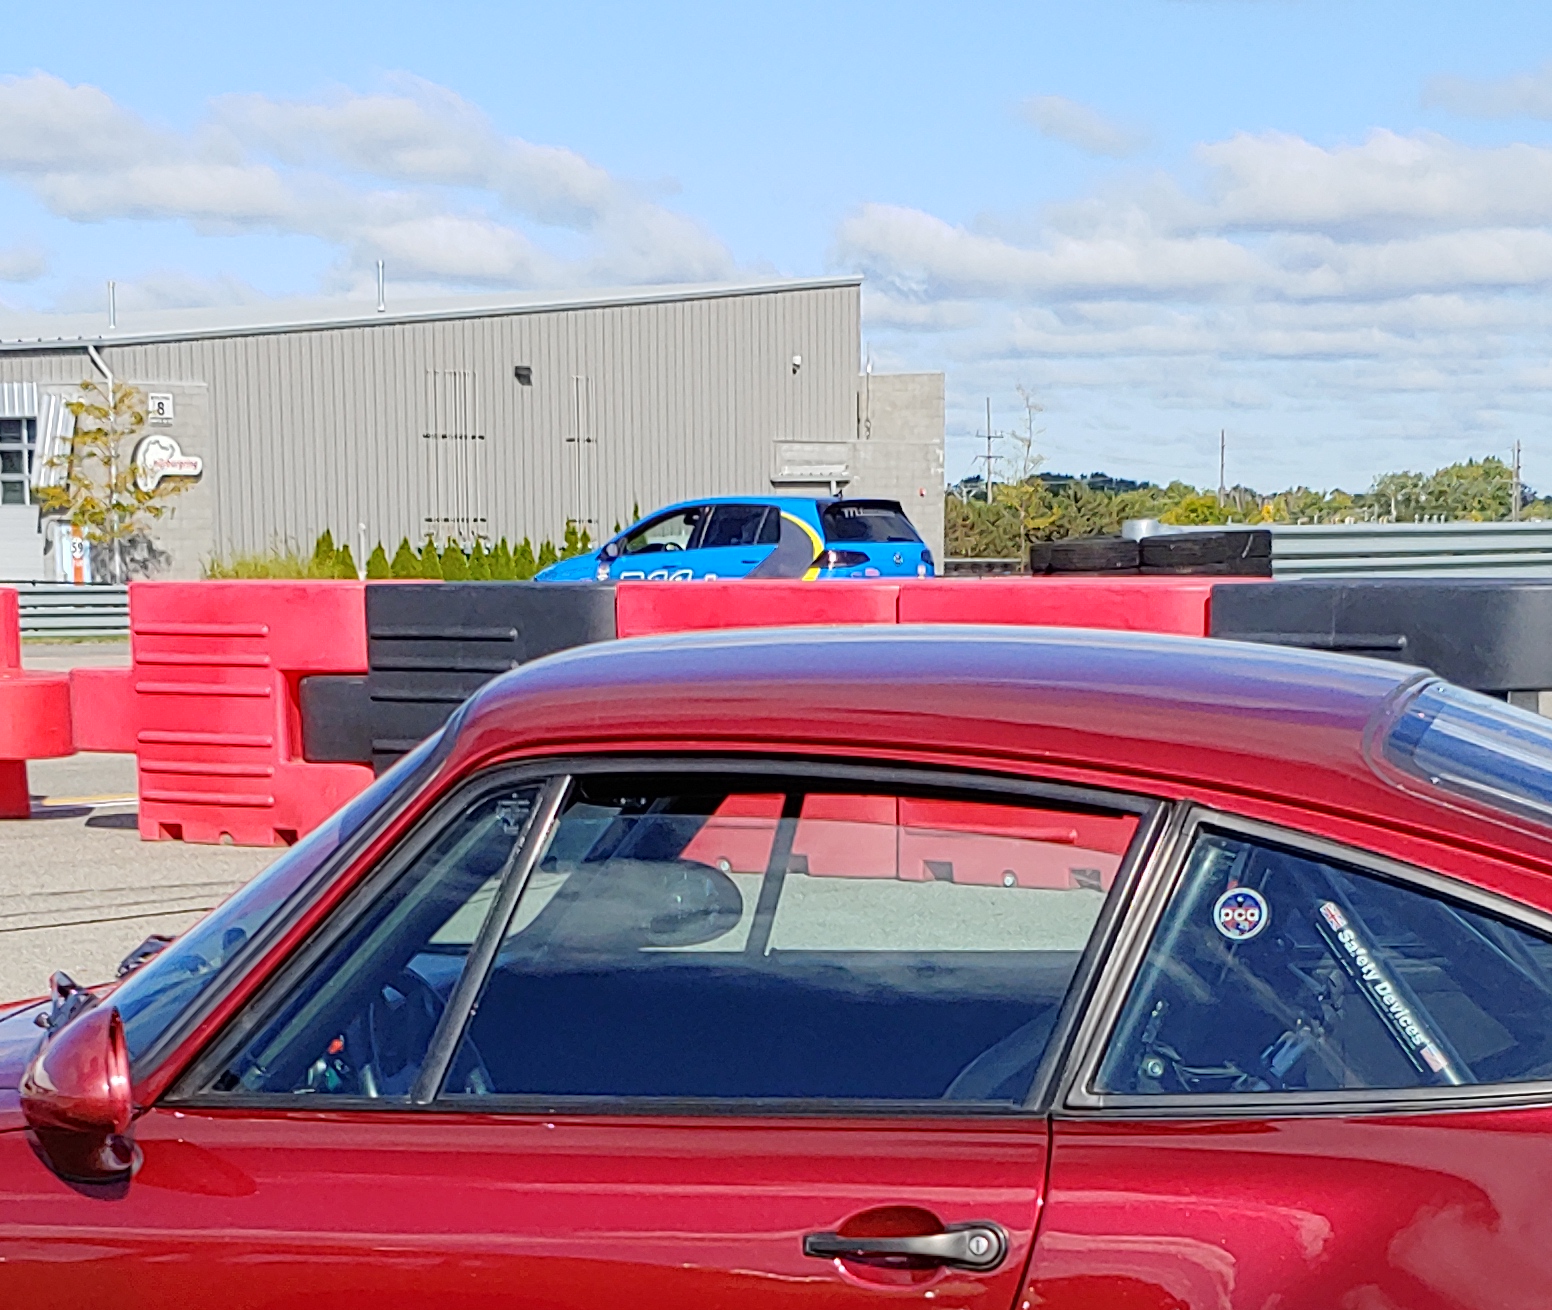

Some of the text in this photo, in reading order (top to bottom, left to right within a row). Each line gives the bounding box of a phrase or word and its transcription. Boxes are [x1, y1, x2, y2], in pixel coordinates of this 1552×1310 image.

[157, 401, 165, 416] 8
[72, 542, 83, 552] 59
[1220, 907, 1259, 922] pca
[1337, 928, 1380, 981] Safety
[1374, 981, 1425, 1045] Devices
